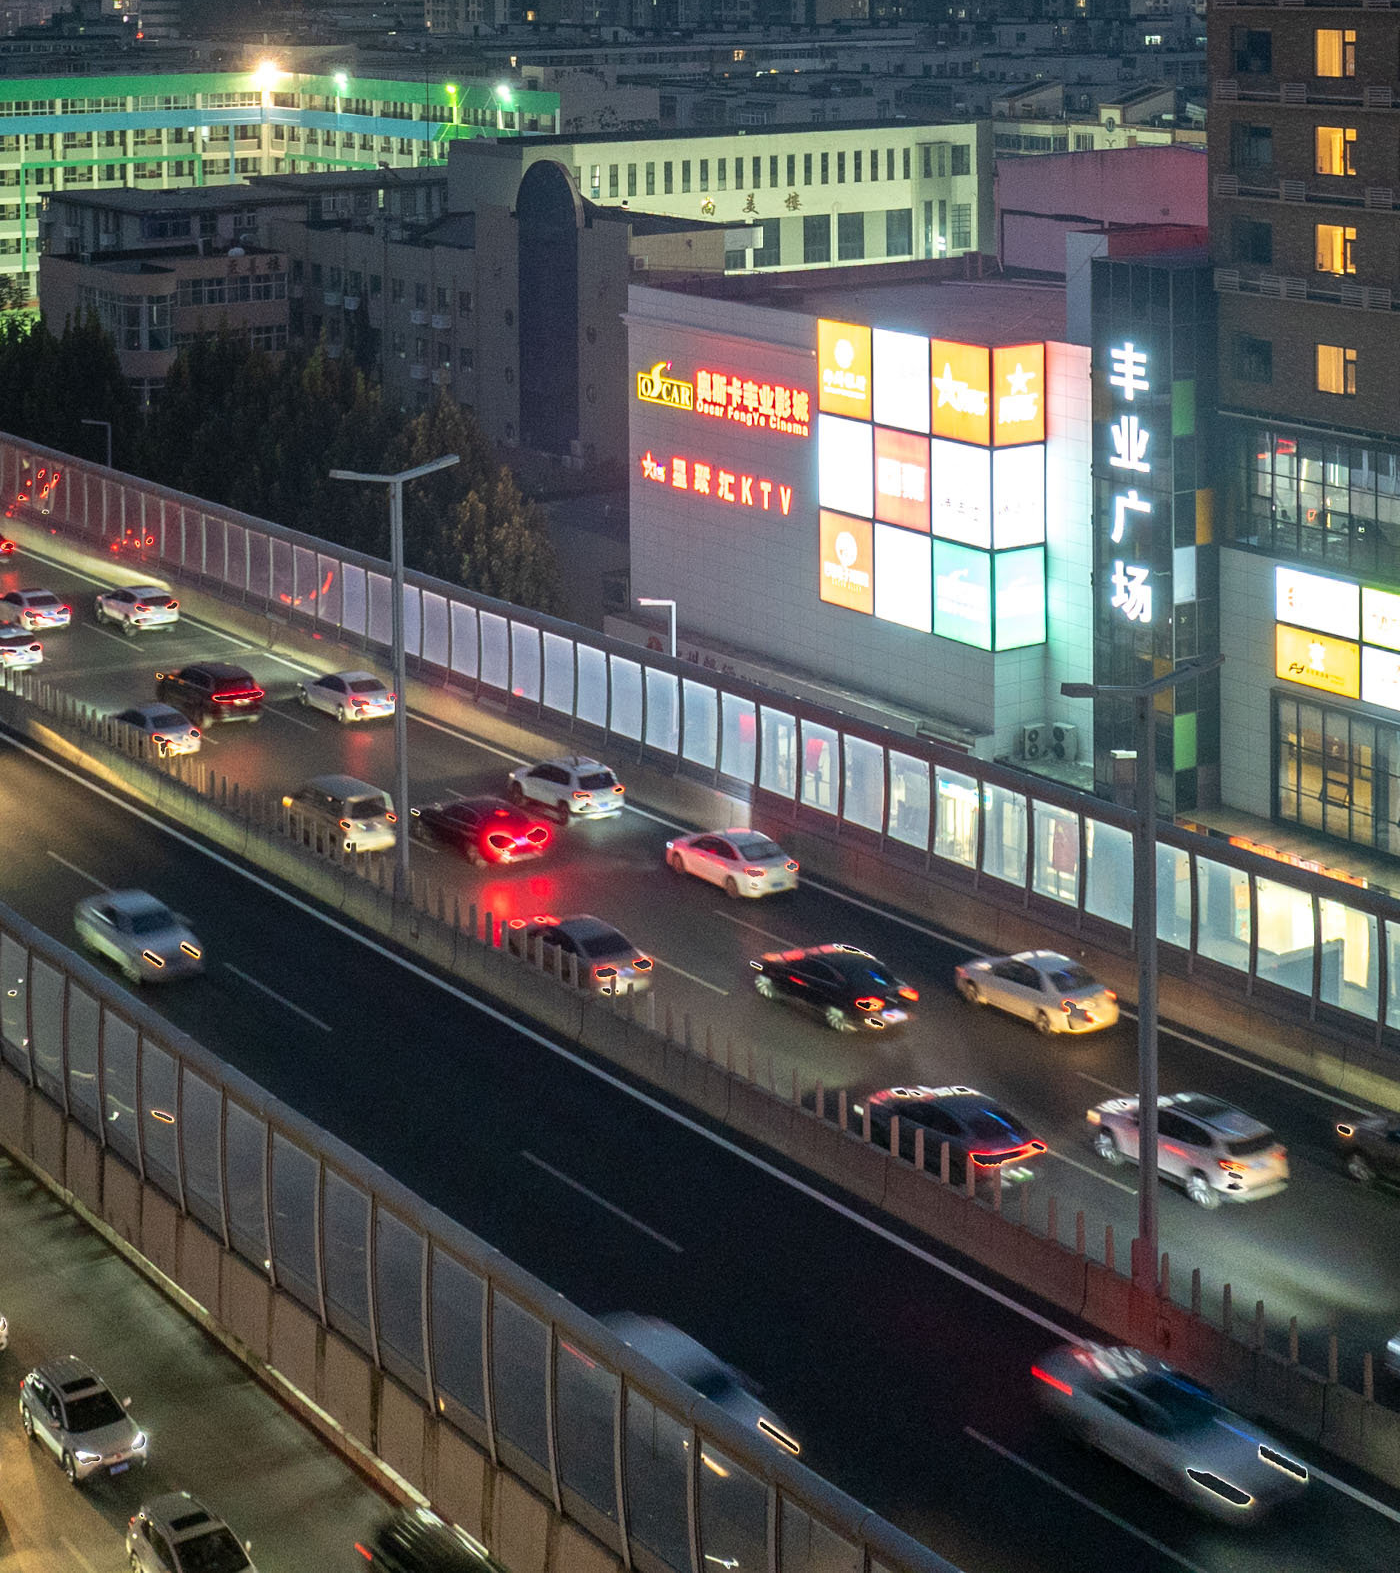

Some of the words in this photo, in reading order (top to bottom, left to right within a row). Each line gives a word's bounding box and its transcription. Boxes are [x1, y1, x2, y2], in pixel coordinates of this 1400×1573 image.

[641, 362, 691, 407] OSCAR
[696, 370, 810, 422] 奥斯卡丰业影城
[696, 401, 725, 418] Oscar
[769, 416, 809, 437] Cinema
[1110, 342, 1151, 623] 丰业广场
